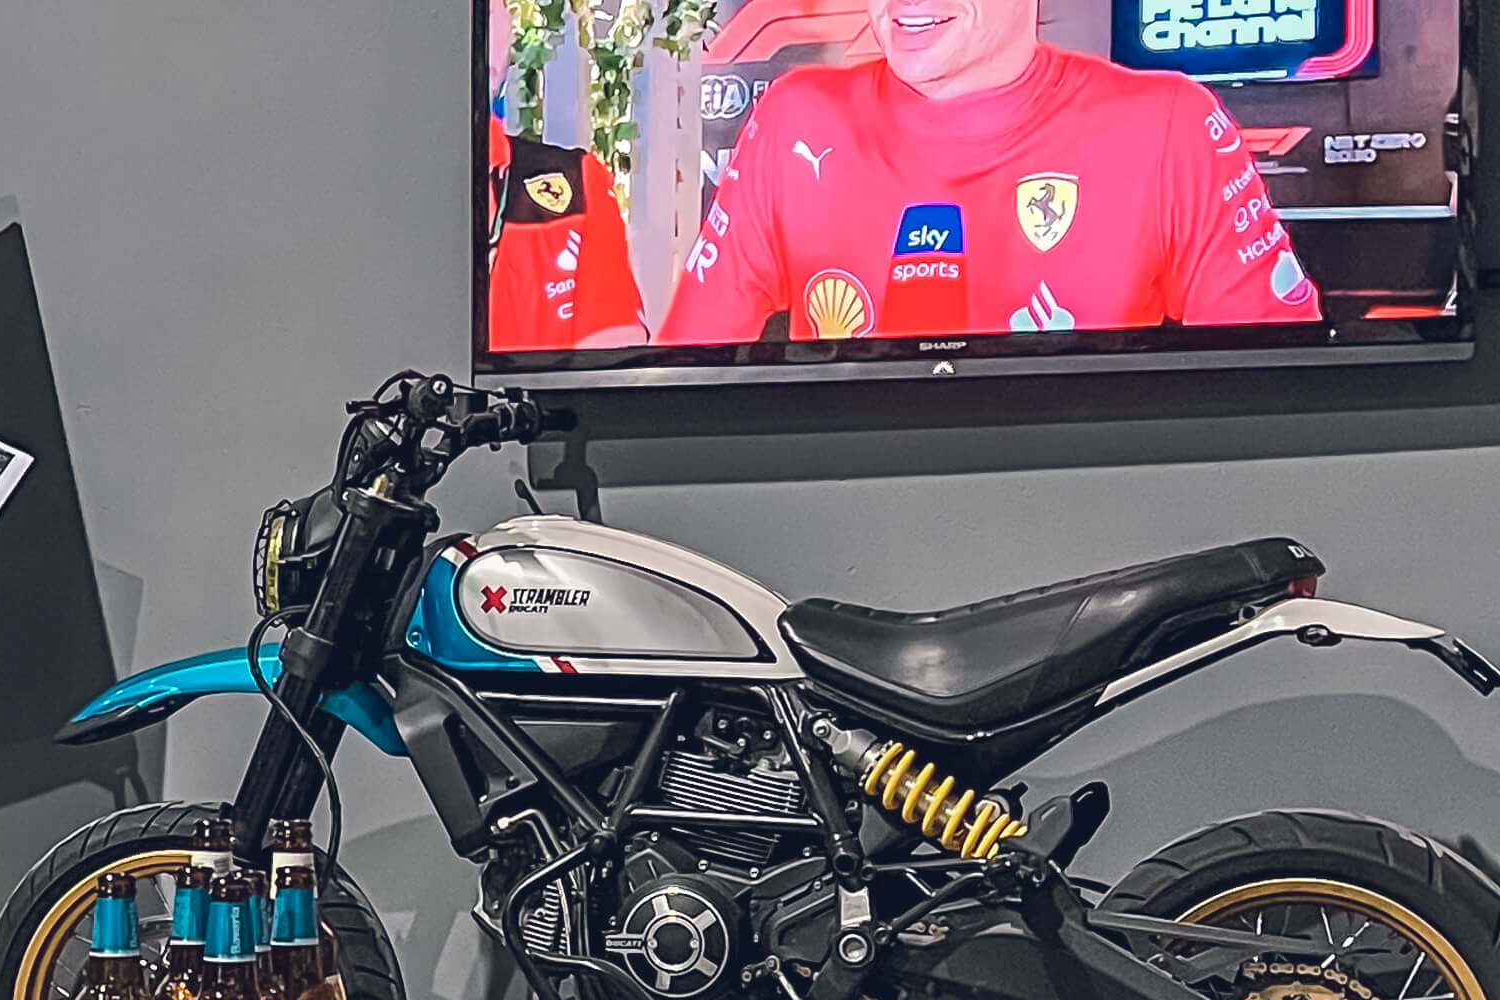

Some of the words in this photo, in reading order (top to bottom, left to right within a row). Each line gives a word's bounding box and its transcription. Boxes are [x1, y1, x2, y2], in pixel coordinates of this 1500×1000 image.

[908, 225, 950, 250] sky
[892, 262, 959, 281] sports
[510, 588, 592, 607] SCRAMBLER
[508, 605, 549, 614] DUCATI
